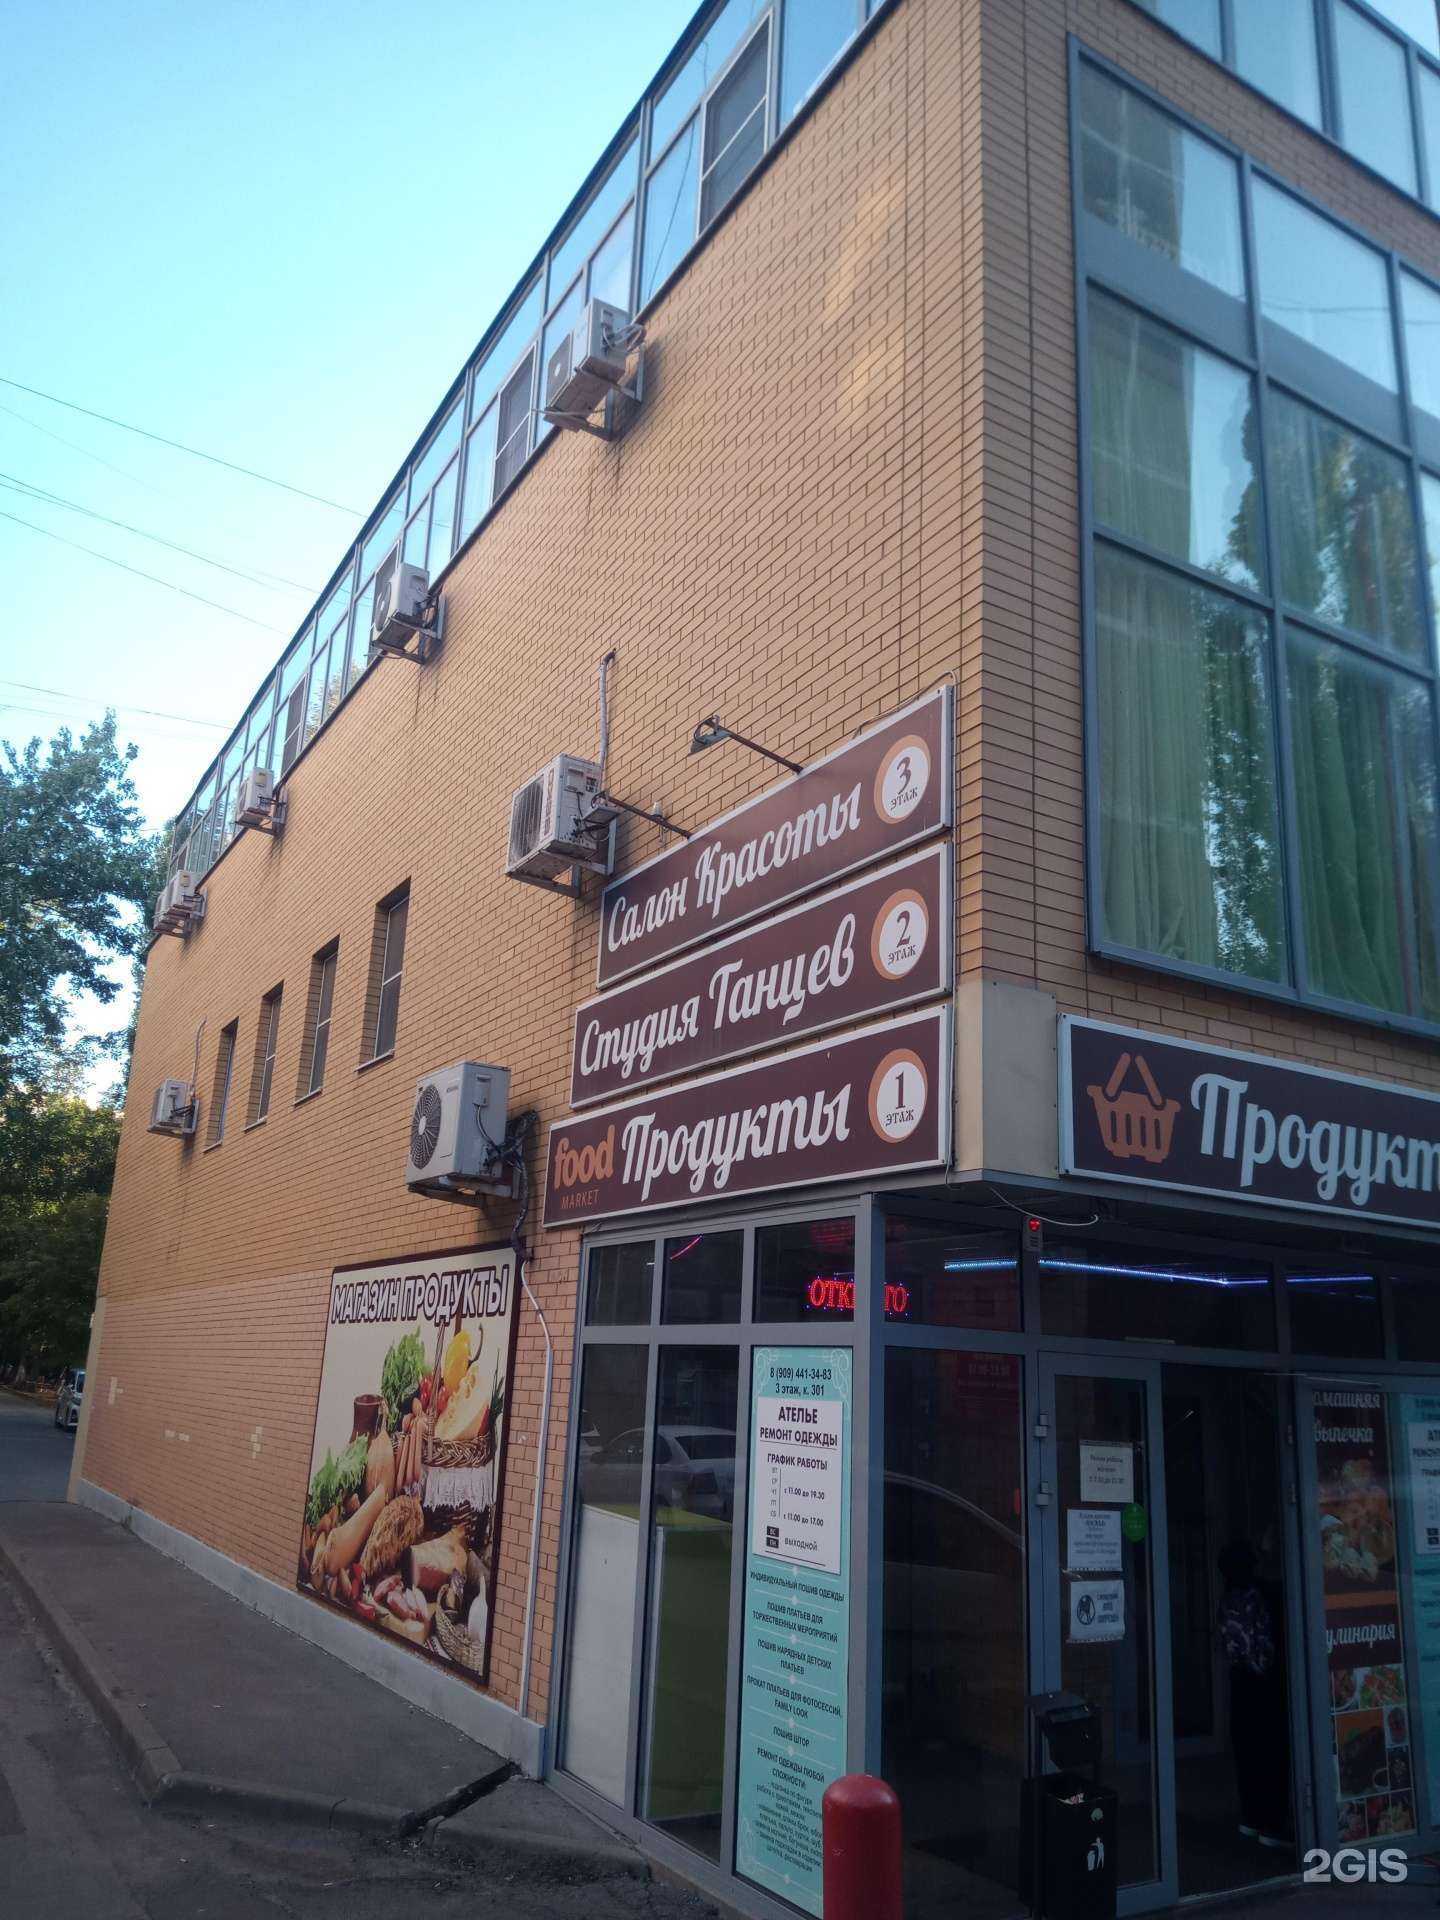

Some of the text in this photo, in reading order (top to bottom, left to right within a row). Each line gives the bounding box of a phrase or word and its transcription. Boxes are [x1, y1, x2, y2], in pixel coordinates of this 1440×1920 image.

[896, 756, 912, 795] 3
[890, 787, 918, 811] ЭТАЖ
[608, 782, 862, 952] Салон Красоты
[896, 910, 911, 948] 2
[887, 944, 917, 964] ЭТАЖ
[580, 913, 856, 1079] Студия Танцев
[894, 1071, 906, 1109] 1
[885, 1109, 915, 1127] ЭТАЖ
[621, 1083, 851, 1202] Продукты
[554, 1124, 616, 1190] food
[560, 1189, 599, 1210] MARKET
[331, 1264, 510, 1327] МАГАЗИН ПРОДУКТЫ
[810, 1279, 908, 1312] ОТКТО
[770, 1367, 832, 1380] 8 (909) 441-34-83
[775, 1383, 781, 1394] 3
[811, 1384, 825, 1396] 301
[778, 1405, 818, 1424] АТЕЛЬЕ
[760, 1426, 838, 1447] РЕМОНТ ОДЕЖДЫ
[767, 1453, 828, 1471] ГРАФИК РАБОТЫ
[799, 1583, 818, 1596] ПОШИВ
[818, 1588, 844, 1602] ОДЕЖДЫ
[786, 1607, 811, 1621] ПЛАТЬЕВ
[1326, 1623, 1396, 1653] улинария
[780, 1660, 805, 1675] ПЛАТЬЕВ
[793, 1706, 808, 1719] LOOK
[794, 1734, 810, 1748] ШТОР
